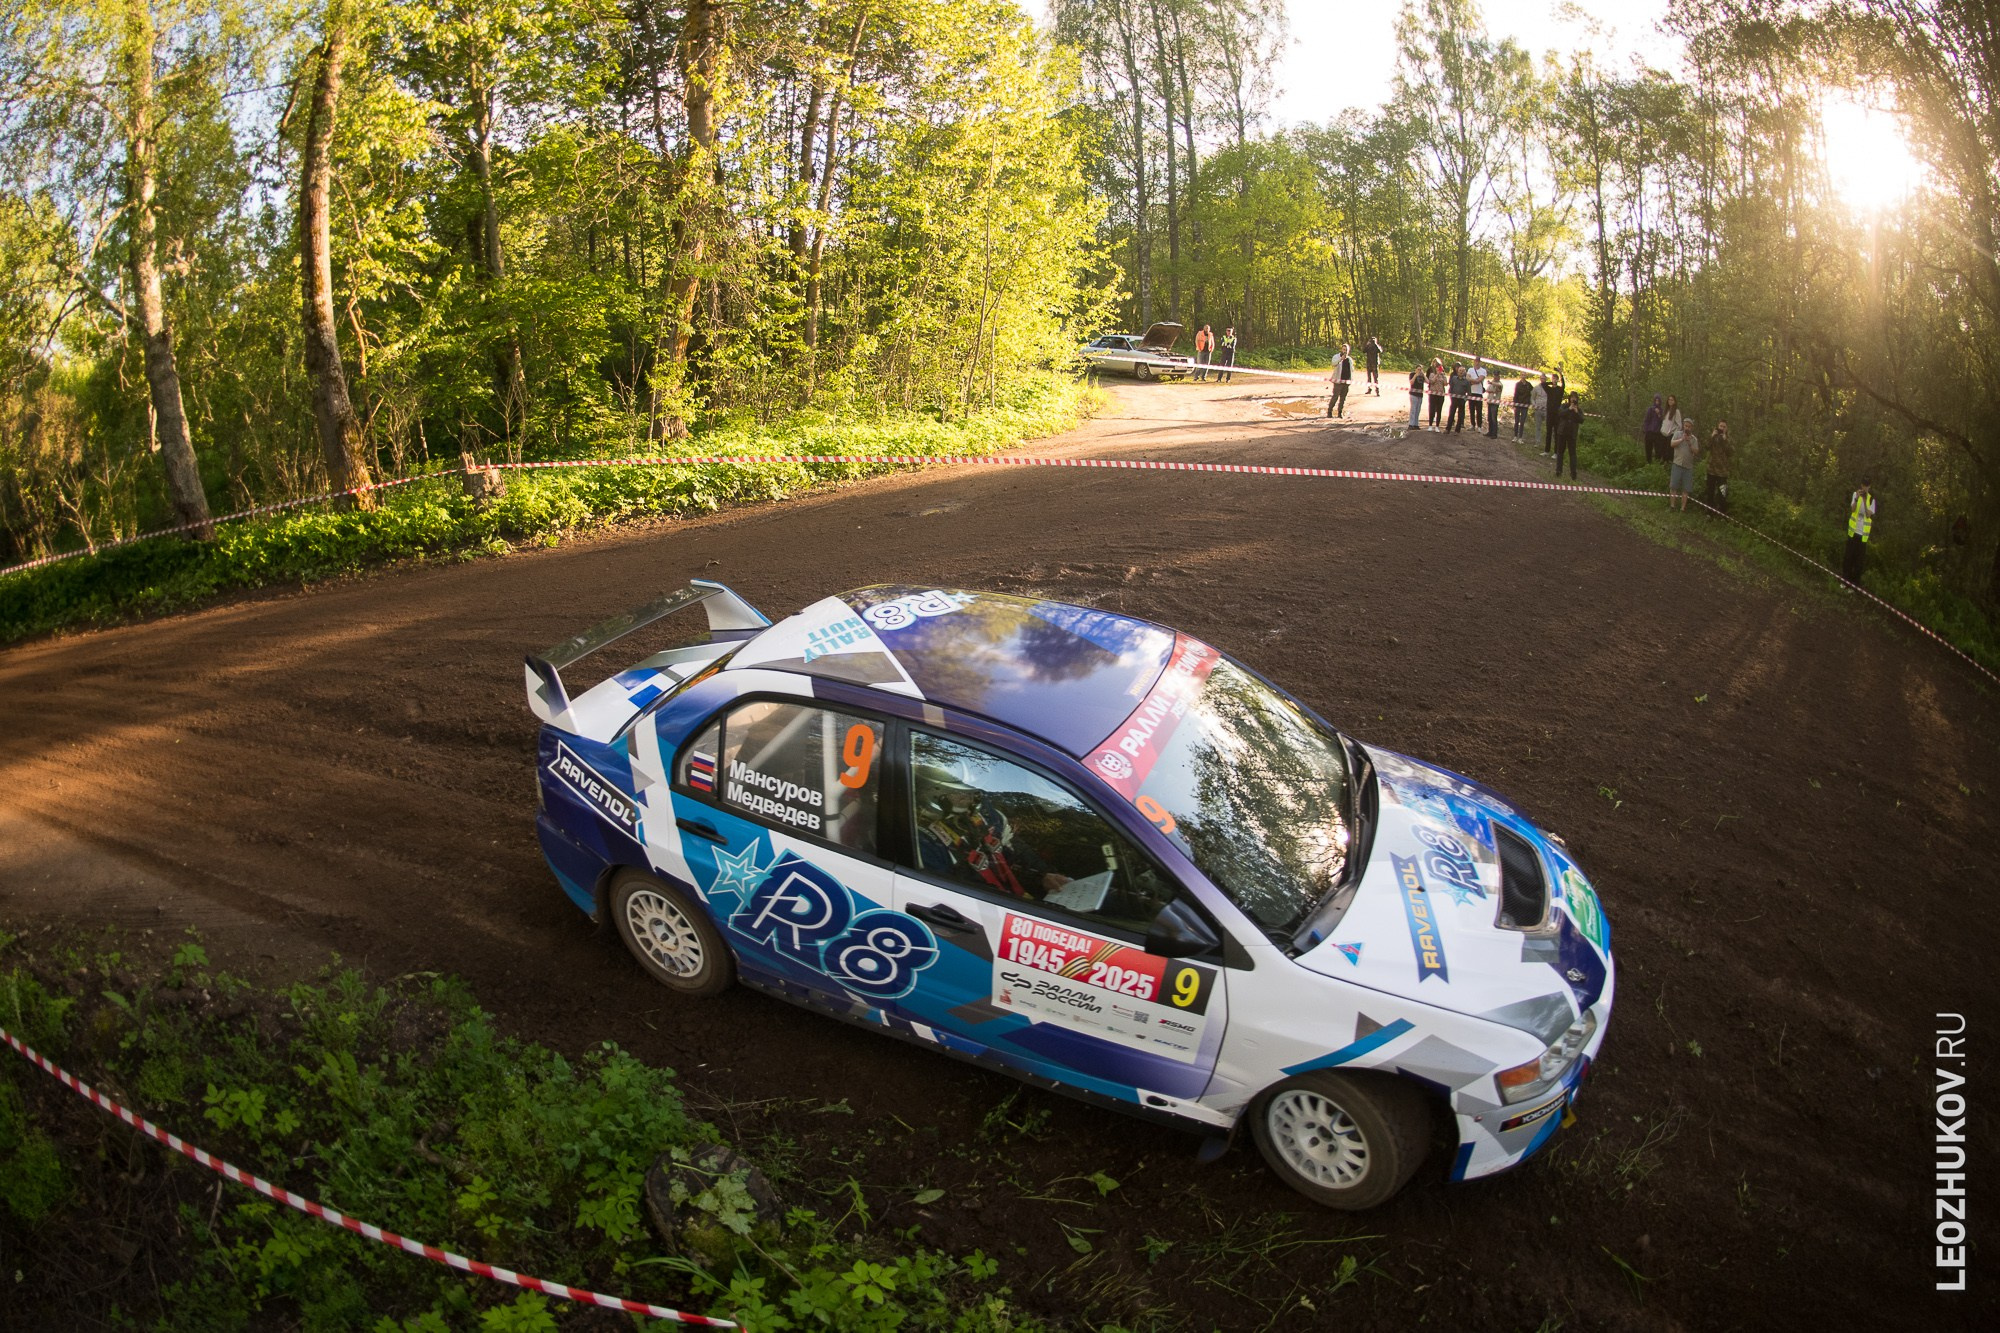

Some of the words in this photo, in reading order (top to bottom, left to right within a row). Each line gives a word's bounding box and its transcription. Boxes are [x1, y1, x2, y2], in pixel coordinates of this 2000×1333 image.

[803, 627, 872, 664] RALLY
[808, 617, 862, 644] HUIT
[1119, 694, 1173, 758] РАЛЛИ
[840, 723, 875, 789] 9
[560, 756, 635, 827] RAVENOL
[729, 760, 823, 807] Мансуров
[727, 782, 821, 830] Медведев
[1135, 795, 1176, 835] 9
[1010, 917, 1031, 938] 80
[1034, 924, 1092, 954] ПОБЕДА!
[1401, 862, 1441, 969] RAVENOL
[1008, 938, 1066, 975] 1945
[1088, 961, 1155, 1000] 2025
[1171, 967, 1200, 1007] 9
[1031, 987, 1102, 1013] РОССИИ
[1036, 980, 1096, 1003] РАЛЛИ
